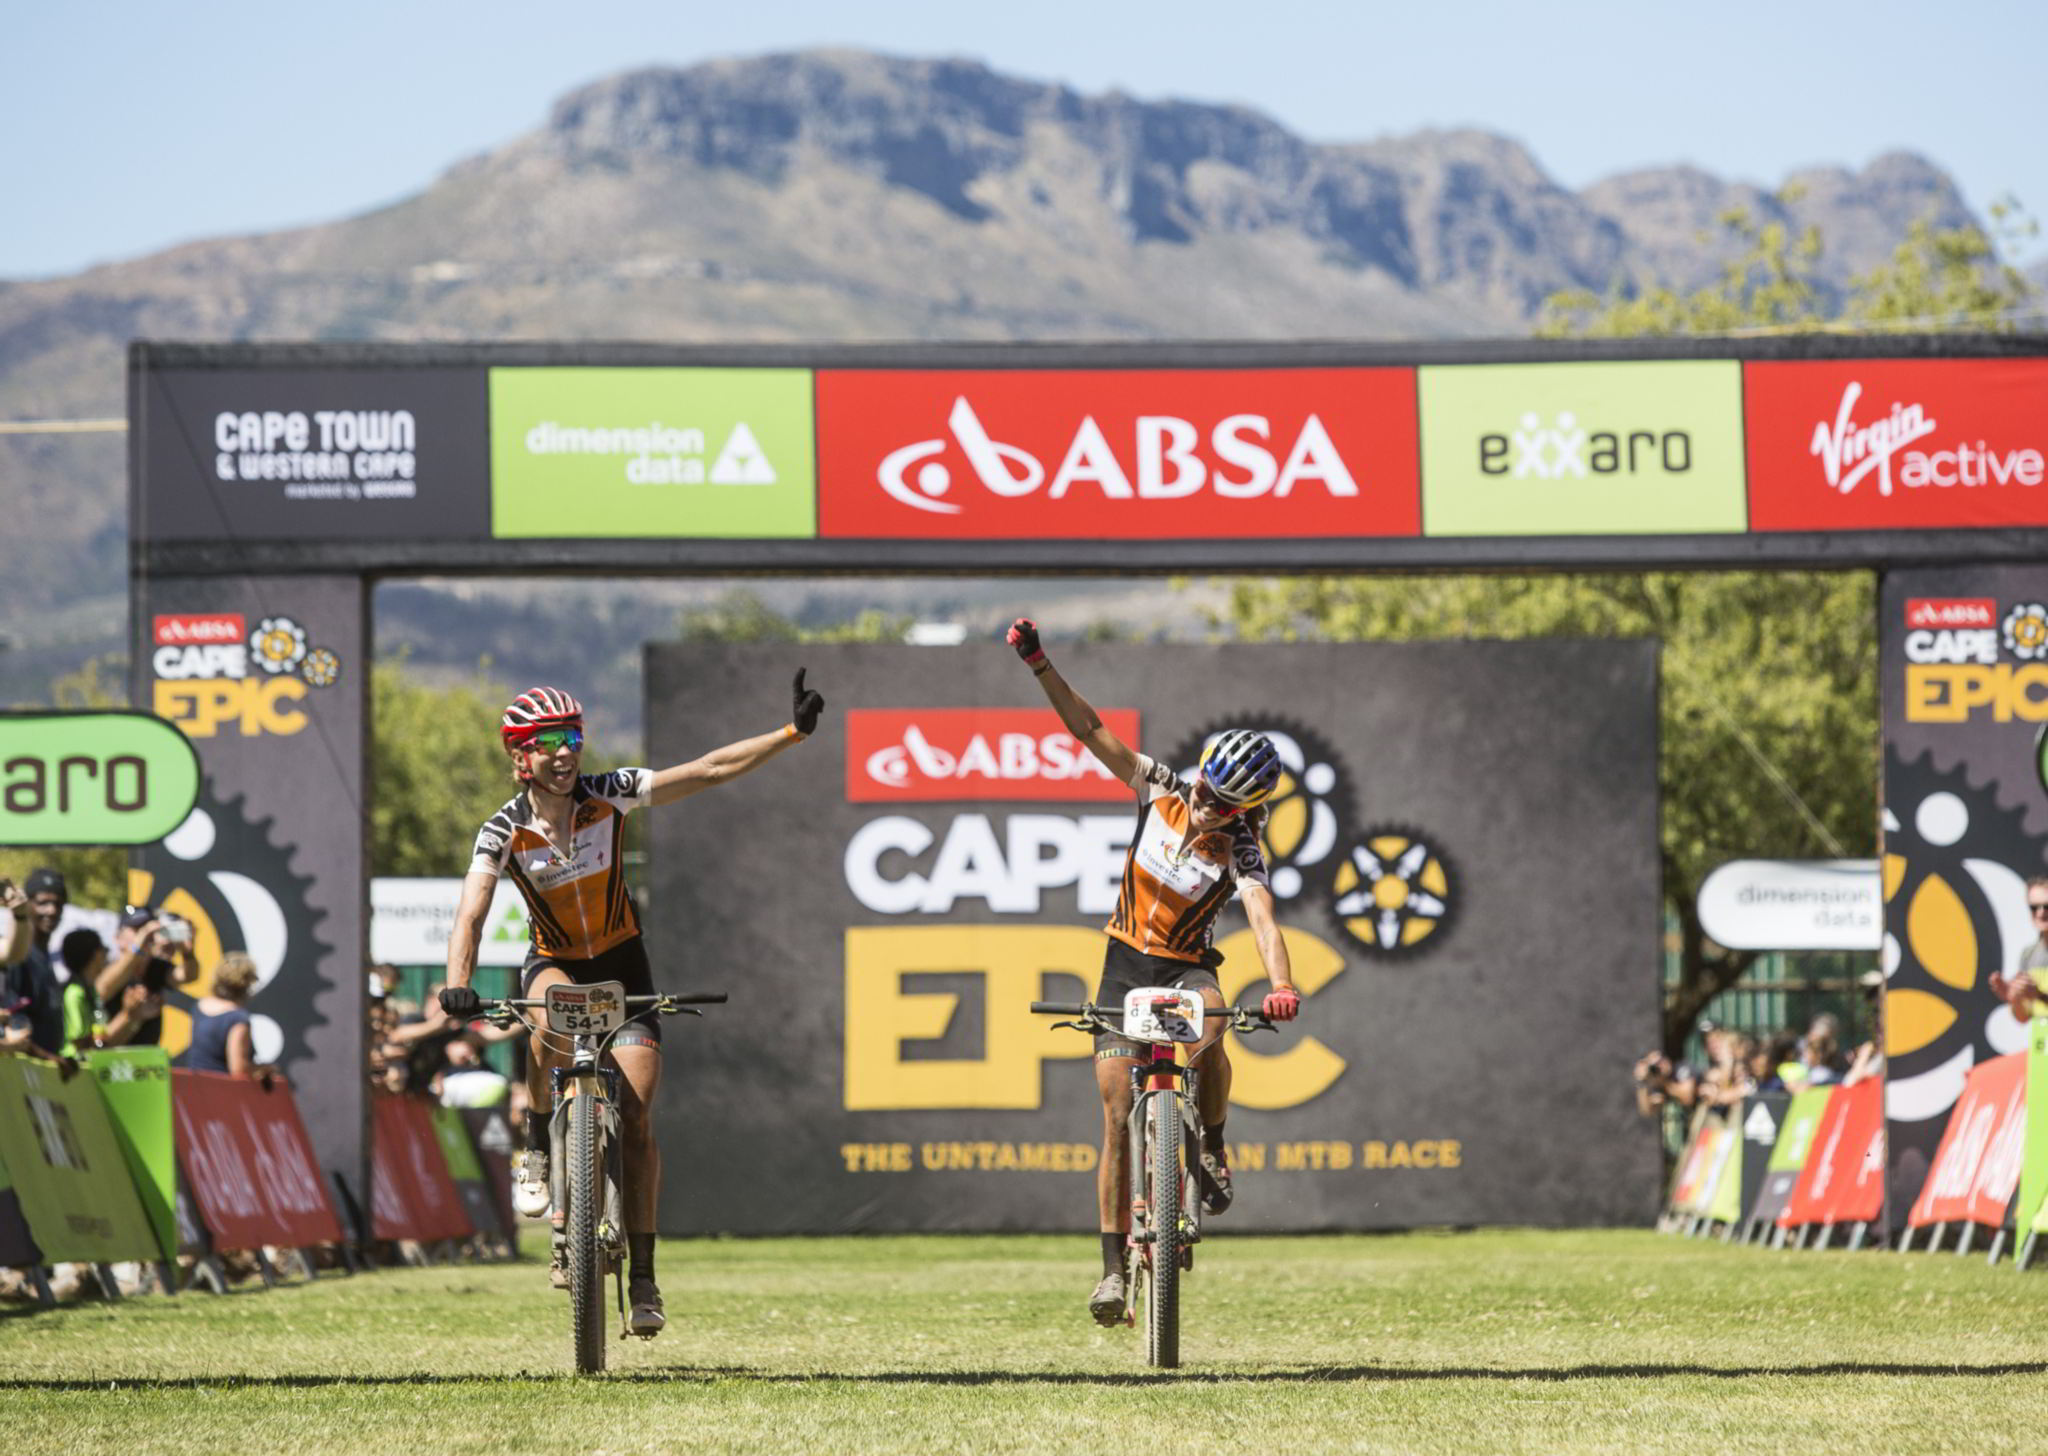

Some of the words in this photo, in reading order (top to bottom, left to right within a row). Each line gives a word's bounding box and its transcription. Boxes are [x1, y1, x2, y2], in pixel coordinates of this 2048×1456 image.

[314, 409, 415, 452] TOWN
[525, 421, 704, 454] dimension
[1479, 412, 1692, 480] exxaro
[1810, 381, 1936, 497] Virgin
[216, 452, 236, 480] &
[626, 453, 704, 484] data
[1049, 413, 1360, 499] ABSA
[1900, 439, 2045, 488] active
[152, 644, 247, 679] CAPE
[1904, 629, 1998, 664] CAPE
[153, 676, 308, 738] EPIC
[844, 813, 1137, 915] CAPE
[566, 1013, 608, 1029] 54-1
[845, 924, 1347, 1110] EPC
[1141, 1020, 1188, 1036] 54-2
[841, 1143, 912, 1171] THE
[922, 1142, 1098, 1171] UNTAMED
[1275, 1141, 1352, 1170] MTB
[1363, 1139, 1462, 1169] RACE
